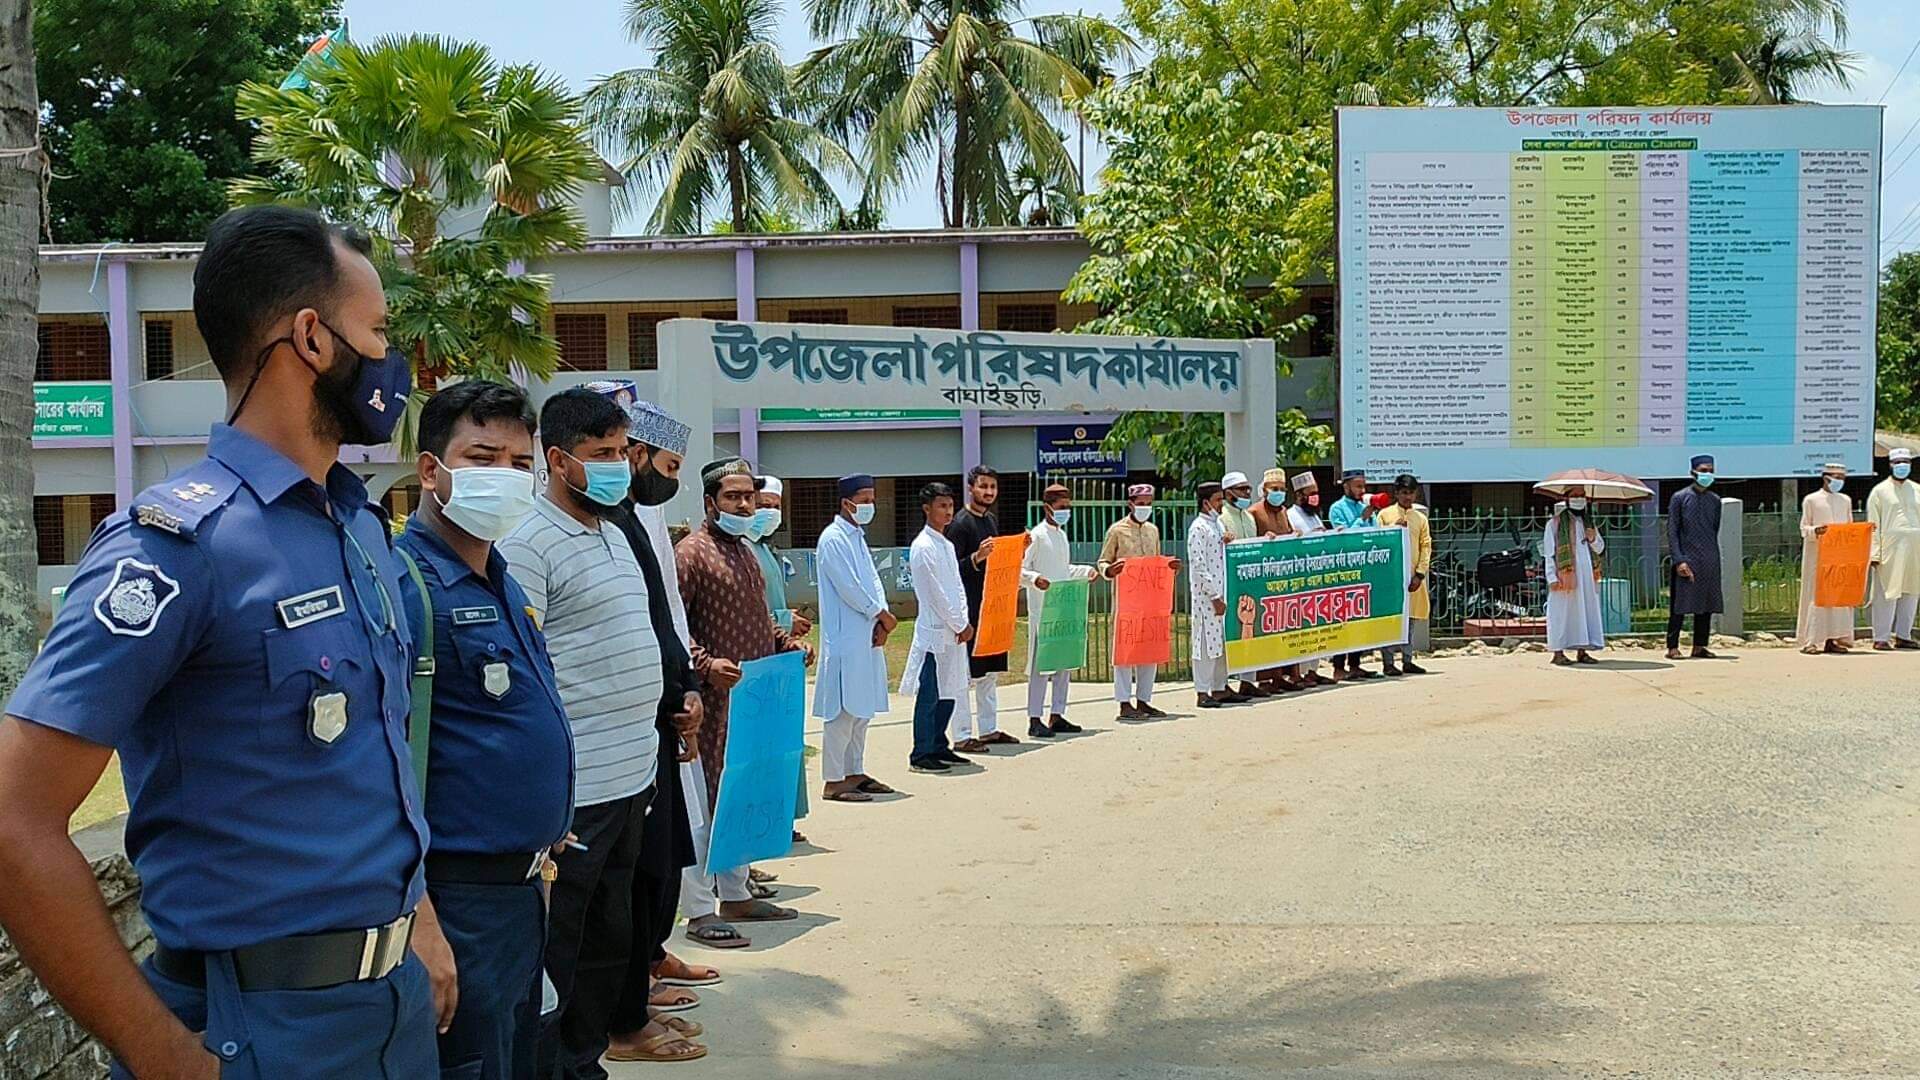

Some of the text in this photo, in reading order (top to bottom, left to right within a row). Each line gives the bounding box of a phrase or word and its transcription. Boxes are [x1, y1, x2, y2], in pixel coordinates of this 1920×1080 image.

[1506, 107, 1712, 126] উপজেলা পরিষদ কার্যালয়
[1606, 139, 1647, 150] (Citizen
[1651, 139, 1697, 150] Charter)
[711, 322, 1241, 393] উপজেলা পরিষদ কার্যালয়
[35, 396, 105, 418] সারের কার্যালয়
[1126, 565, 1168, 592] SAVE
[1260, 583, 1371, 634] মানববন্ধন
[738, 672, 797, 718] SAVE
